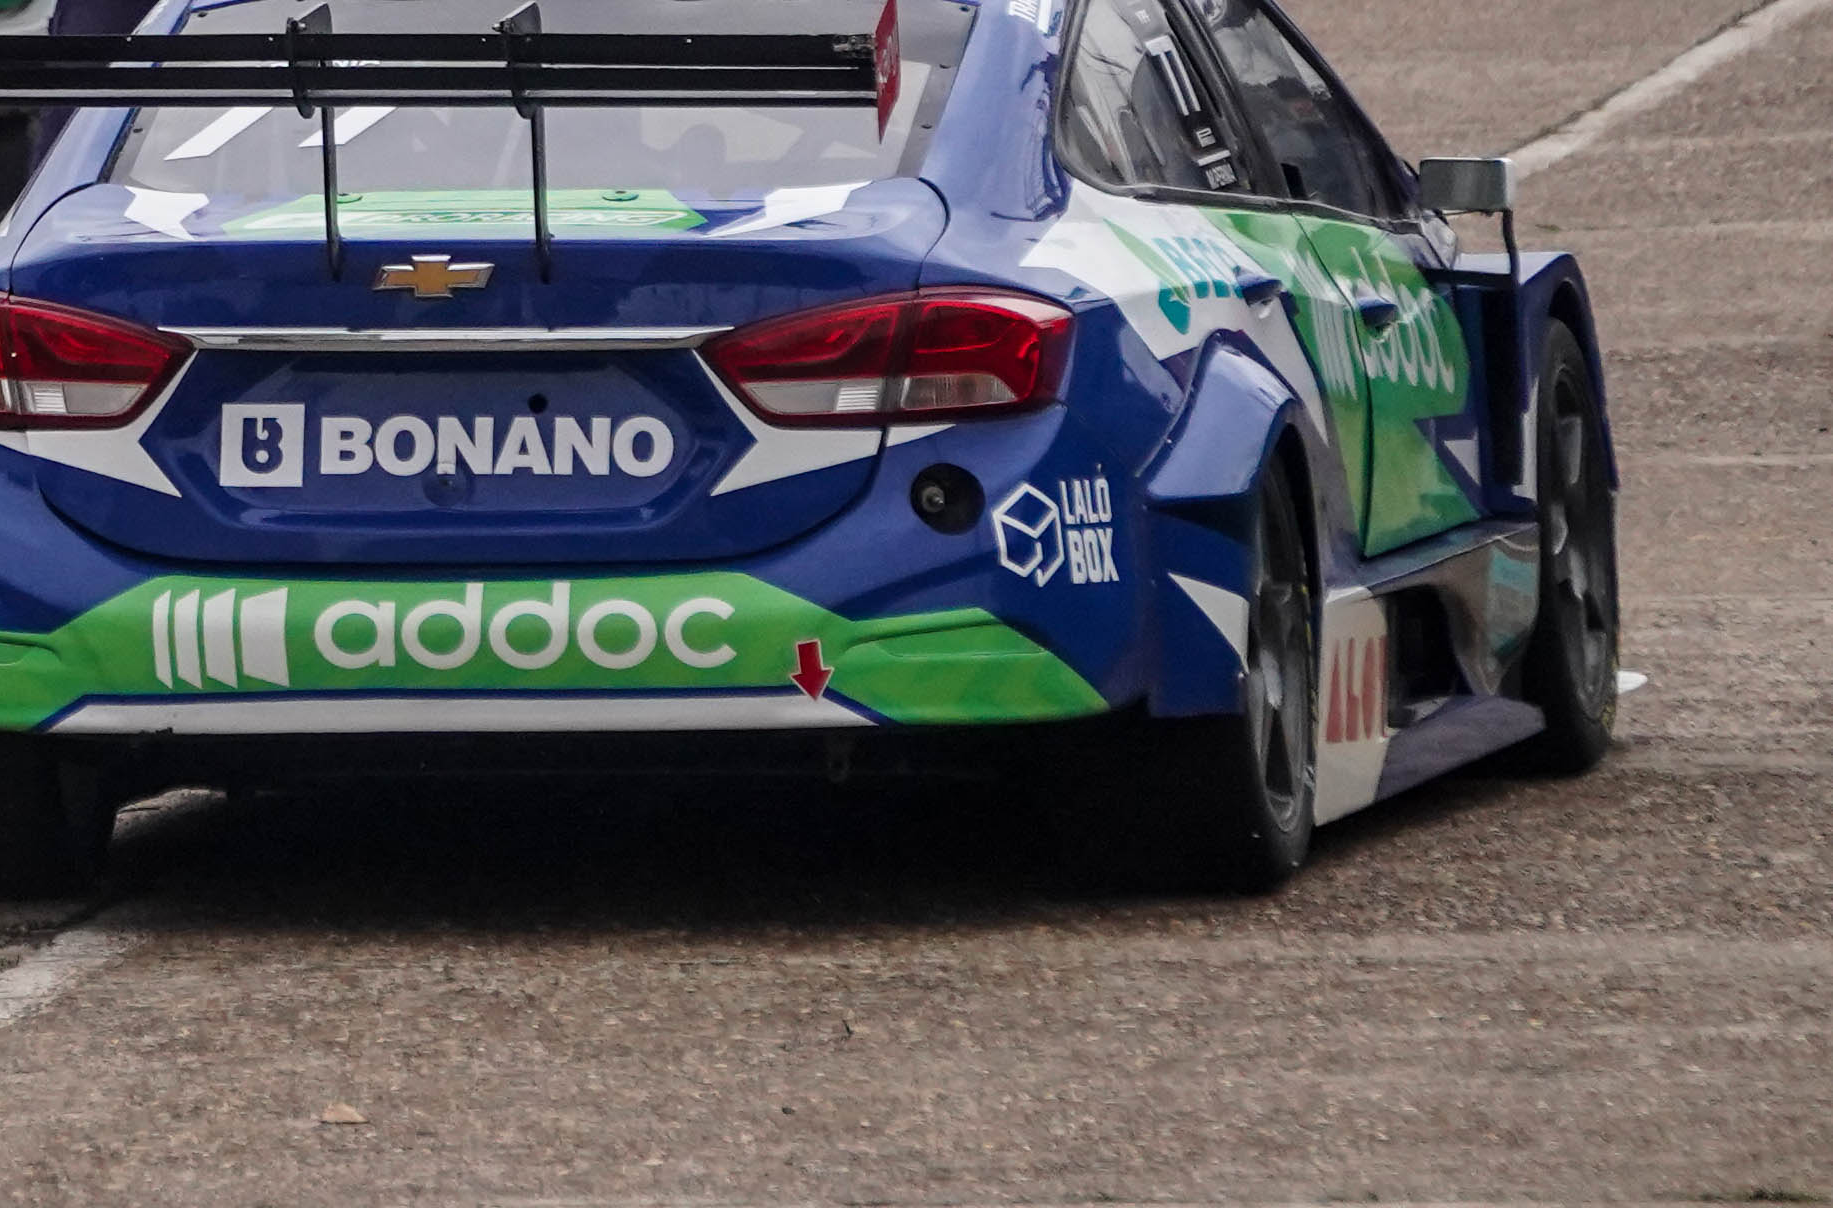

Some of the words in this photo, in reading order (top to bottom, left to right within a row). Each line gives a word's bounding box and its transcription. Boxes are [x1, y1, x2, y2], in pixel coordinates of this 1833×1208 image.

[320, 414, 676, 478] BONANO
[1067, 527, 1120, 585] BOX
[314, 581, 737, 670] addoc
